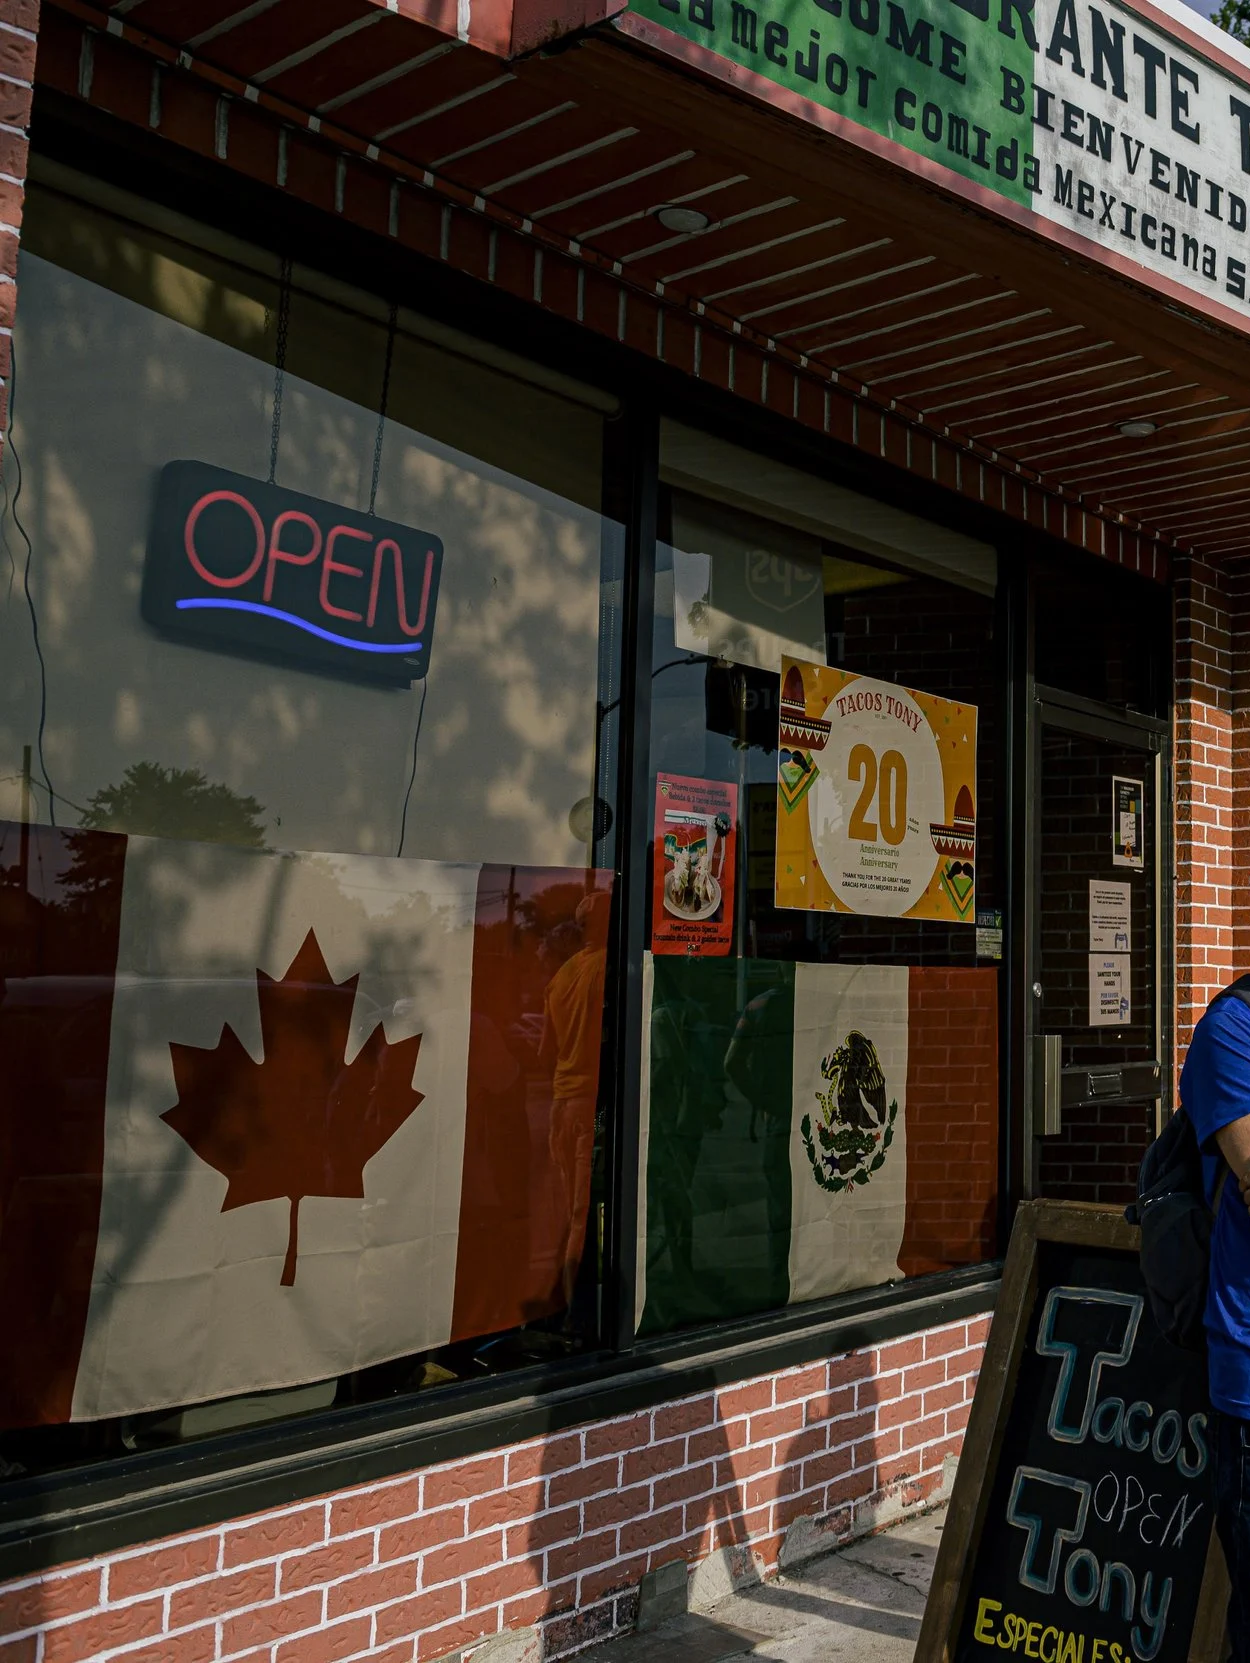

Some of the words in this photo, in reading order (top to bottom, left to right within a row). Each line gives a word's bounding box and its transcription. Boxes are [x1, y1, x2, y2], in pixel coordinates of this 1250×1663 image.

[951, 0, 1200, 145] RANTE
[731, 1, 877, 108] mejor
[894, 87, 1042, 195] comida
[1054, 163, 1217, 281] Mexicana
[184, 490, 434, 636] OPEN
[836, 692, 882, 717] TACOS
[886, 694, 922, 733] TONY
[847, 744, 907, 845] 20
[860, 843, 900, 857] Anniversario
[860, 857, 898, 871] Anniversary
[682, 924, 701, 933] Combo
[702, 925, 719, 934] Special
[1036, 1286, 1208, 1478] Tacos
[1094, 1470, 1203, 1548] OPEN
[1007, 1465, 1173, 1662] Tony
